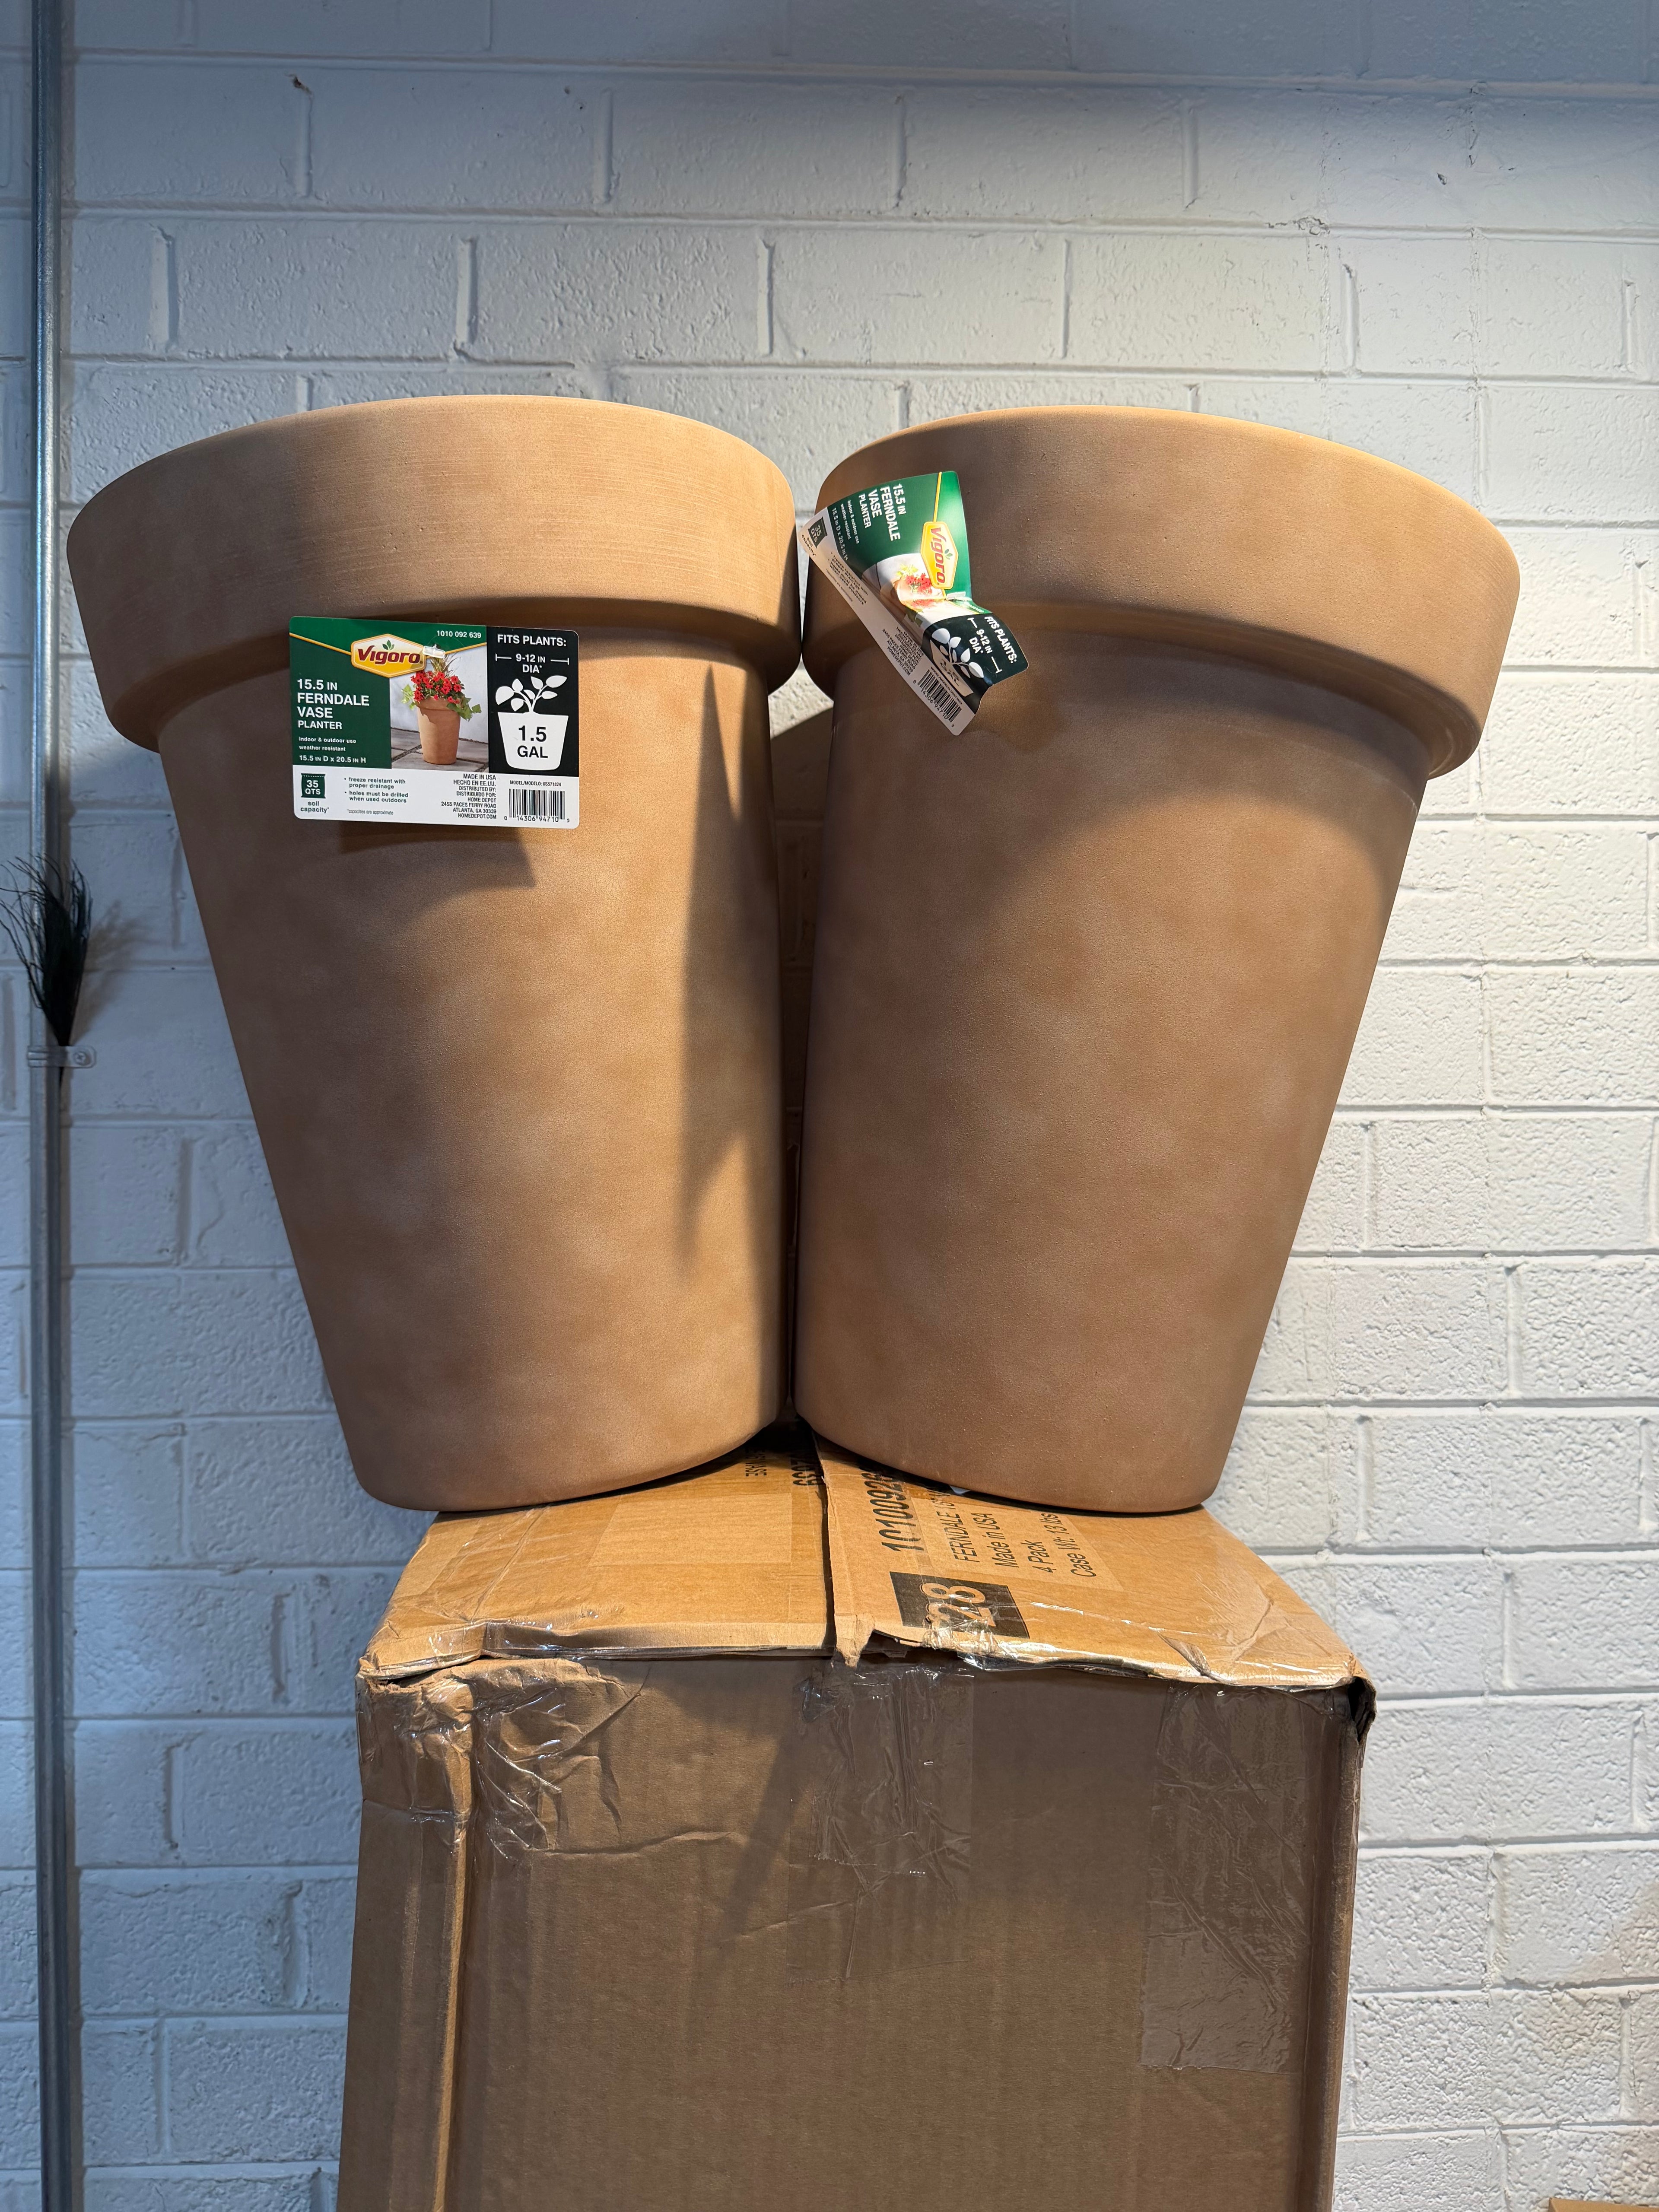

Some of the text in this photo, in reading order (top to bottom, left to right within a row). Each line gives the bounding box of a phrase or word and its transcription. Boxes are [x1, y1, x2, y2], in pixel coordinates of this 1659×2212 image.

[868, 488, 882, 518] VASE
[893, 483, 906, 505] 15.5
[858, 493, 871, 528] PLANTER
[880, 485, 901, 541] FERNDALE
[815, 525, 822, 537] 35
[931, 528, 947, 583] Vigoro
[497, 634, 567, 647] FITS PLANTS:
[976, 629, 993, 654] 9-12 IN
[984, 617, 1017, 664] FITS PLANTS:
[357, 645, 421, 665] Vigoro
[516, 654, 536, 663] 9-12
[297, 679, 337, 690] 15.5 IN
[297, 693, 369, 706] FERNDALE
[297, 706, 333, 718] VASE
[298, 720, 342, 729] PLANTER
[518, 725, 547, 742] 1.5
[517, 746, 548, 759] GAL
[936, 1511, 980, 1562] FERNDALE
[971, 1513, 1019, 1568] Made in USA
[1039, 1513, 1096, 1577] Case Wt: 13 lbs
[1020, 1540, 1053, 1564] Pack
